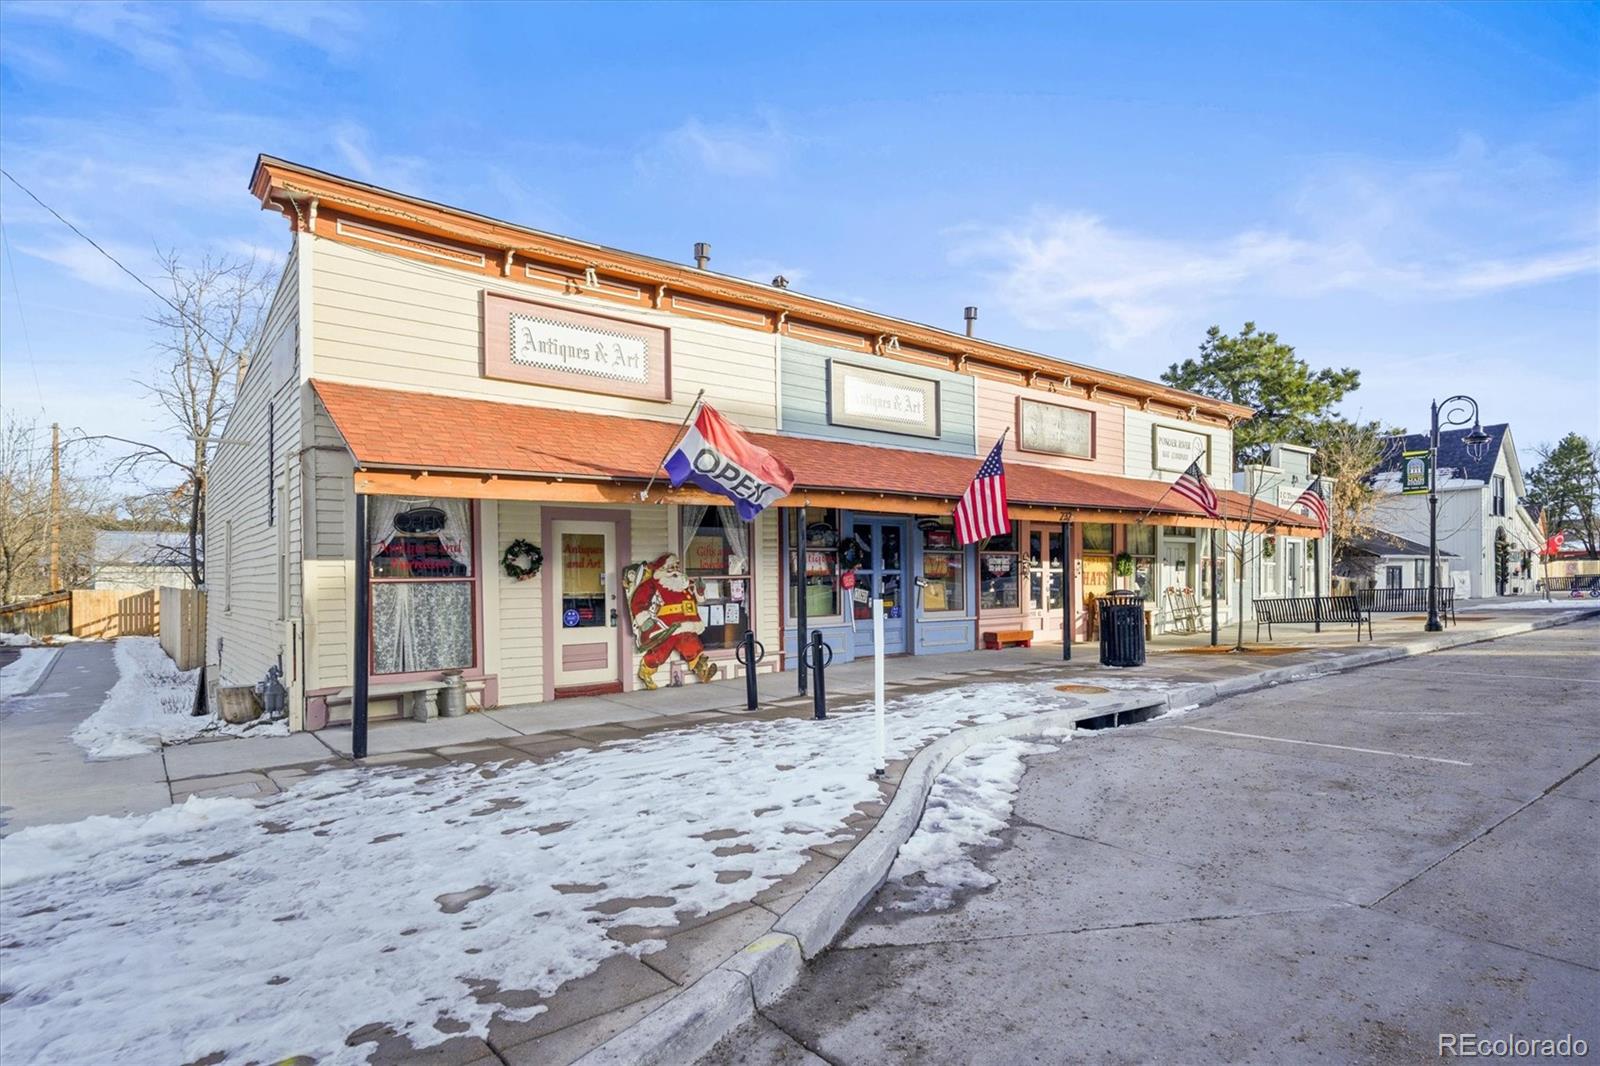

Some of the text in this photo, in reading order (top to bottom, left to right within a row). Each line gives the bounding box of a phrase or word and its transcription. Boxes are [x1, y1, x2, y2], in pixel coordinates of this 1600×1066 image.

[520, 326, 640, 369] Antiques & Art
[893, 393, 903, 410] &
[903, 394, 921, 414] Art
[693, 448, 772, 503] OPEN
[563, 544, 604, 556] Antiques
[697, 544, 716, 557] Gifts
[565, 558, 602, 569] and Art
[1082, 571, 1108, 586] HATS
